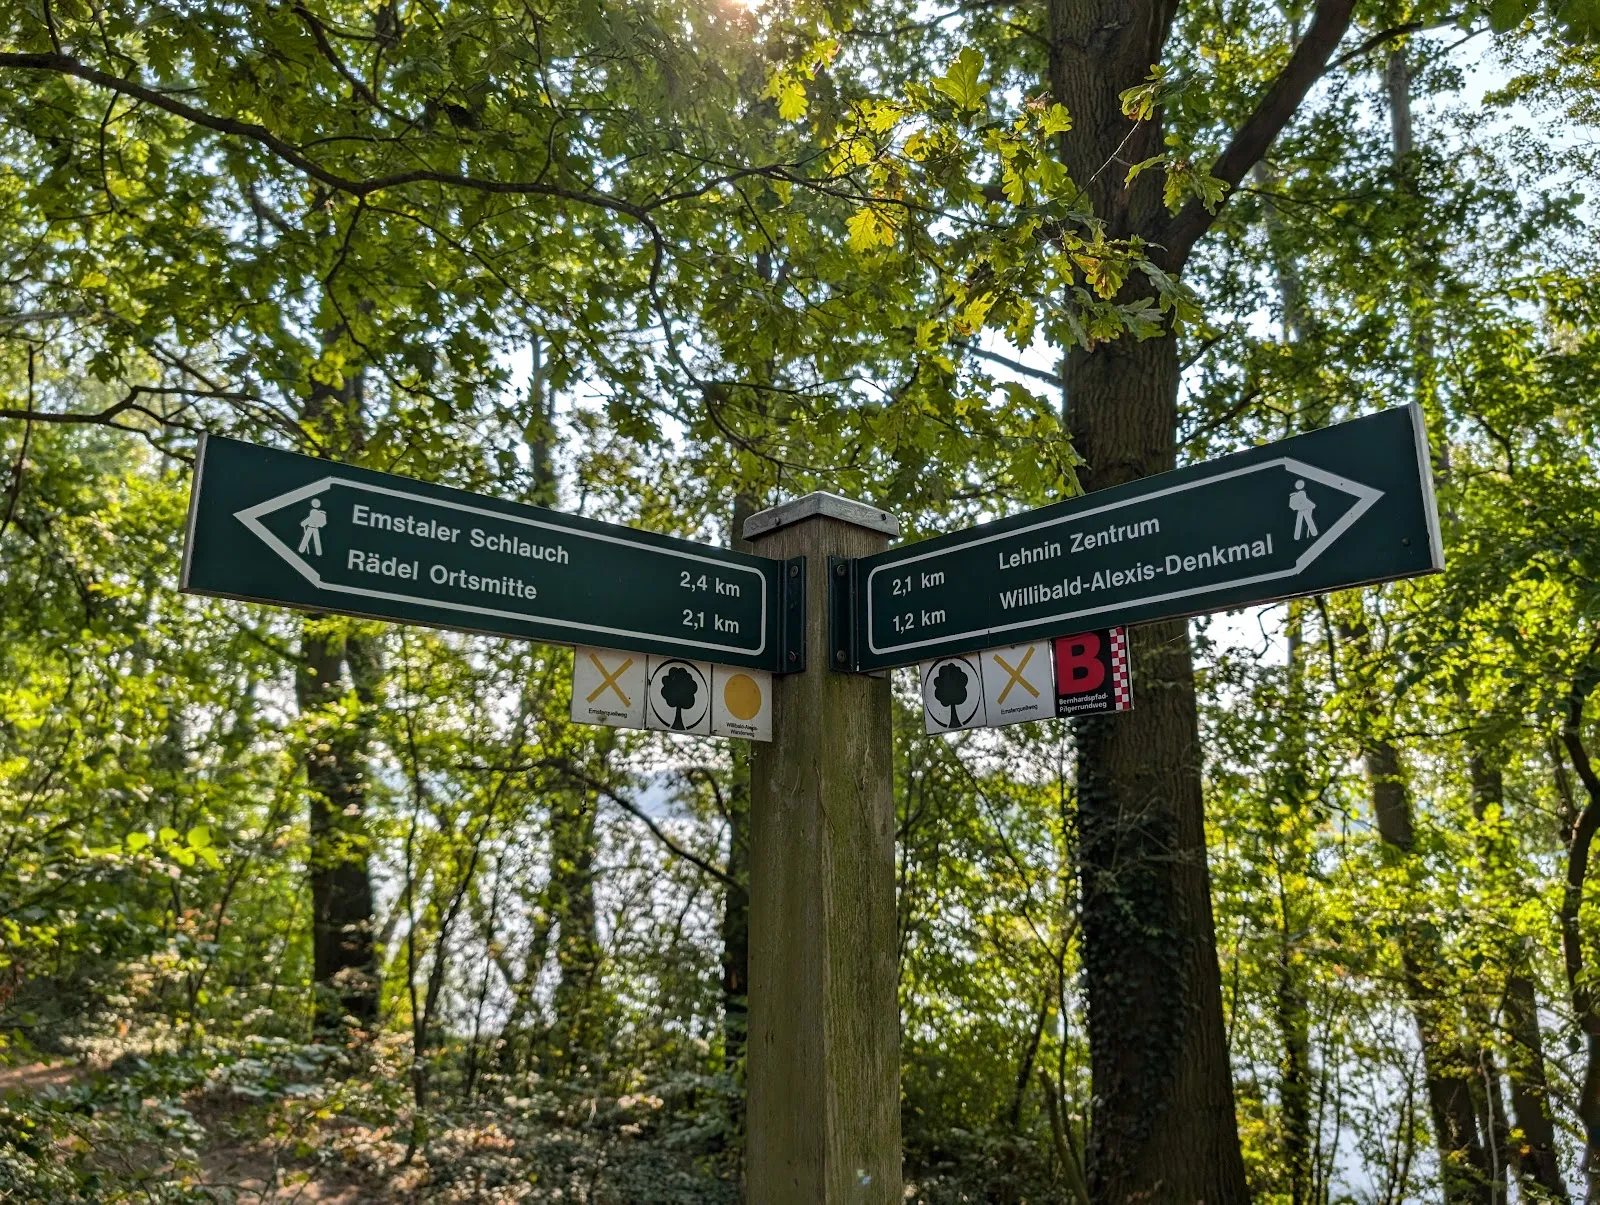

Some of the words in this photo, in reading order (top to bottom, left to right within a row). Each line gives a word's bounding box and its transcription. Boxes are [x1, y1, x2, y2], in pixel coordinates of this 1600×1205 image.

[352, 504, 460, 543] Emstaler
[470, 528, 569, 565] Schlauch
[680, 571, 707, 592] 2,4
[715, 577, 740, 597] km
[892, 576, 911, 596] 2,1
[921, 571, 945, 589] km
[999, 540, 1061, 570] Lehnin
[1069, 518, 1160, 553] Zentrum
[893, 612, 914, 634] 1,2
[921, 609, 946, 626] km
[999, 533, 1273, 610] Willibald-Alexis-Denkmal
[347, 550, 418, 580] Rädel
[430, 565, 537, 599] Ortsmitte
[682, 609, 704, 630] 2,1
[714, 614, 739, 634] km
[1055, 632, 1105, 696] B
[1059, 692, 1108, 705] Bernhardspfad-
[1059, 701, 1107, 714] Pilgerrundweg
